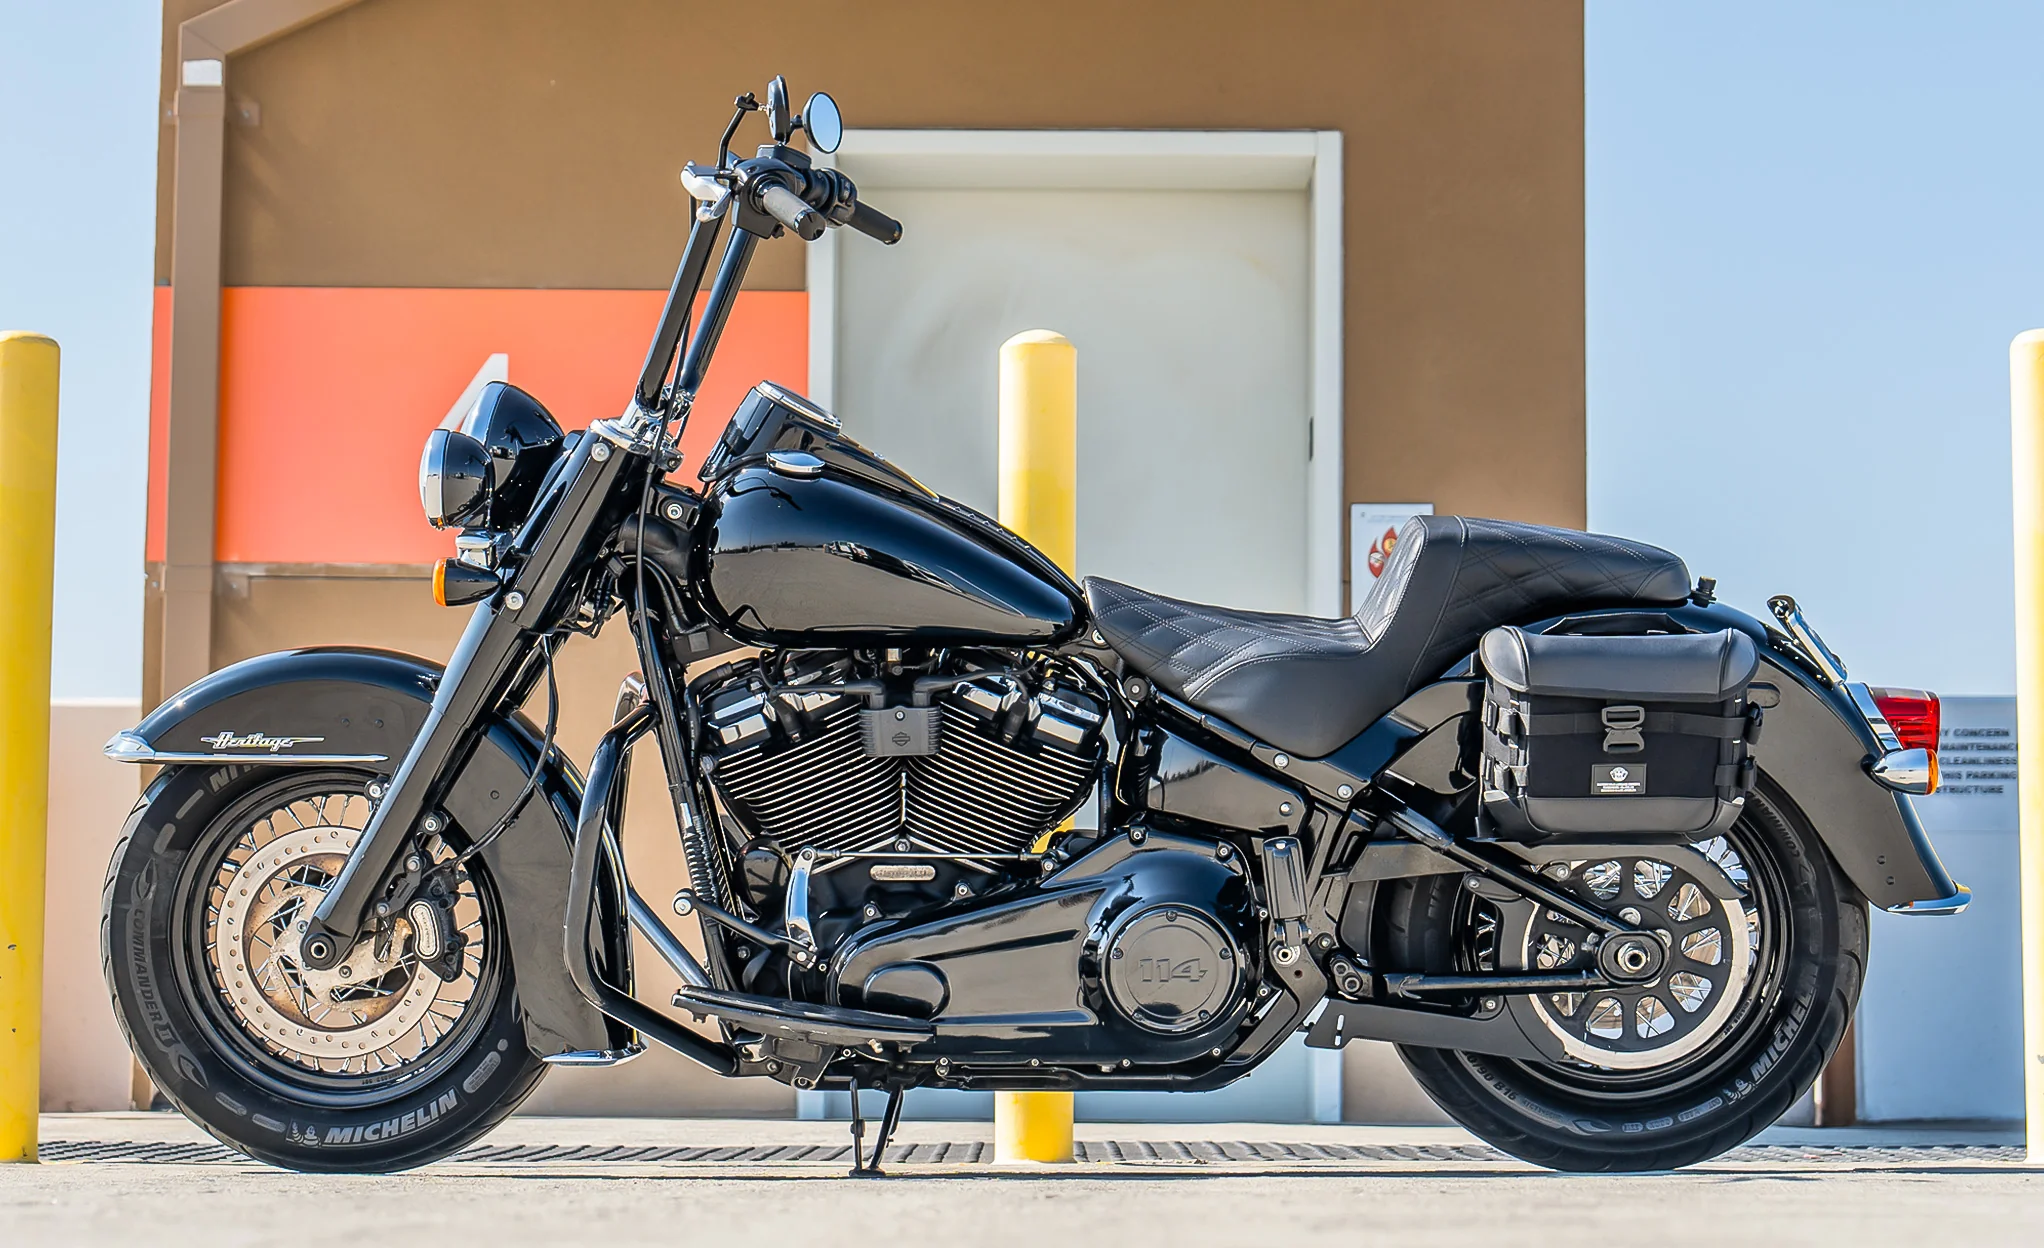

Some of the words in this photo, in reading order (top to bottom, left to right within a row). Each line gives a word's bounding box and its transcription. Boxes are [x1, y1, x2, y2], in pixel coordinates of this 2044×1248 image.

[212, 731, 296, 752] Heritage
[1953, 728, 2010, 737] CONCERN
[1940, 742, 2019, 751] MAINTENANC
[1966, 770, 2017, 780] PARKING
[132, 907, 164, 1022] COMMANDER
[1139, 957, 1209, 983] 114
[1464, 1052, 1496, 1082] 0/90
[324, 1088, 458, 1144] MICHELIN
